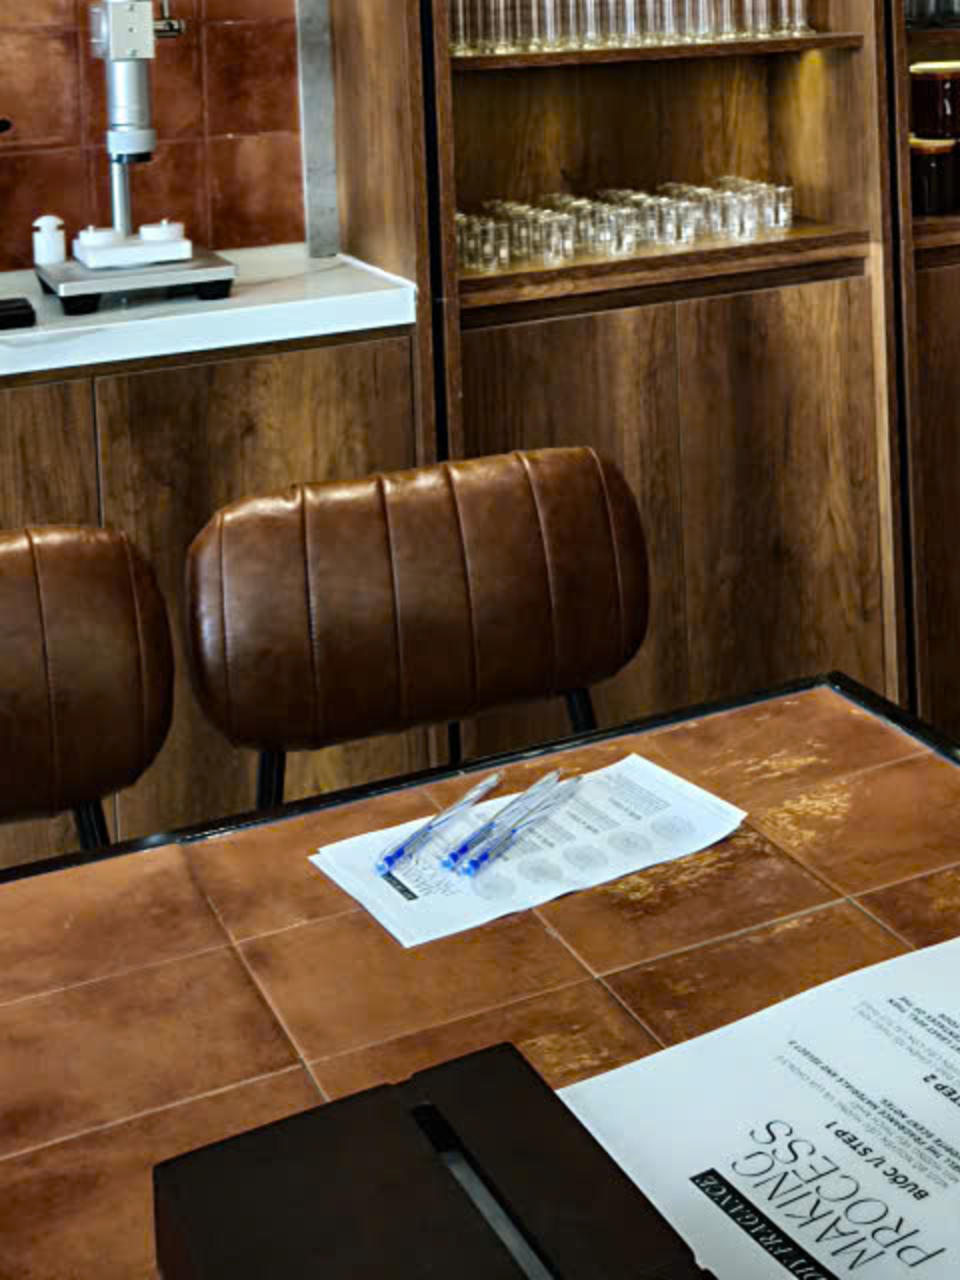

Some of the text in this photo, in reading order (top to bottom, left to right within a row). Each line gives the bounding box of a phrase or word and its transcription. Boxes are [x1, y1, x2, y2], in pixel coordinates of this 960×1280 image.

[833, 1128, 874, 1158] STEP
[695, 1176, 793, 1255] FRAGANCE
[731, 1151, 886, 1271] MAKING
[750, 1121, 946, 1268] PROCESS
[881, 1166, 930, 1201] BƯỚC
